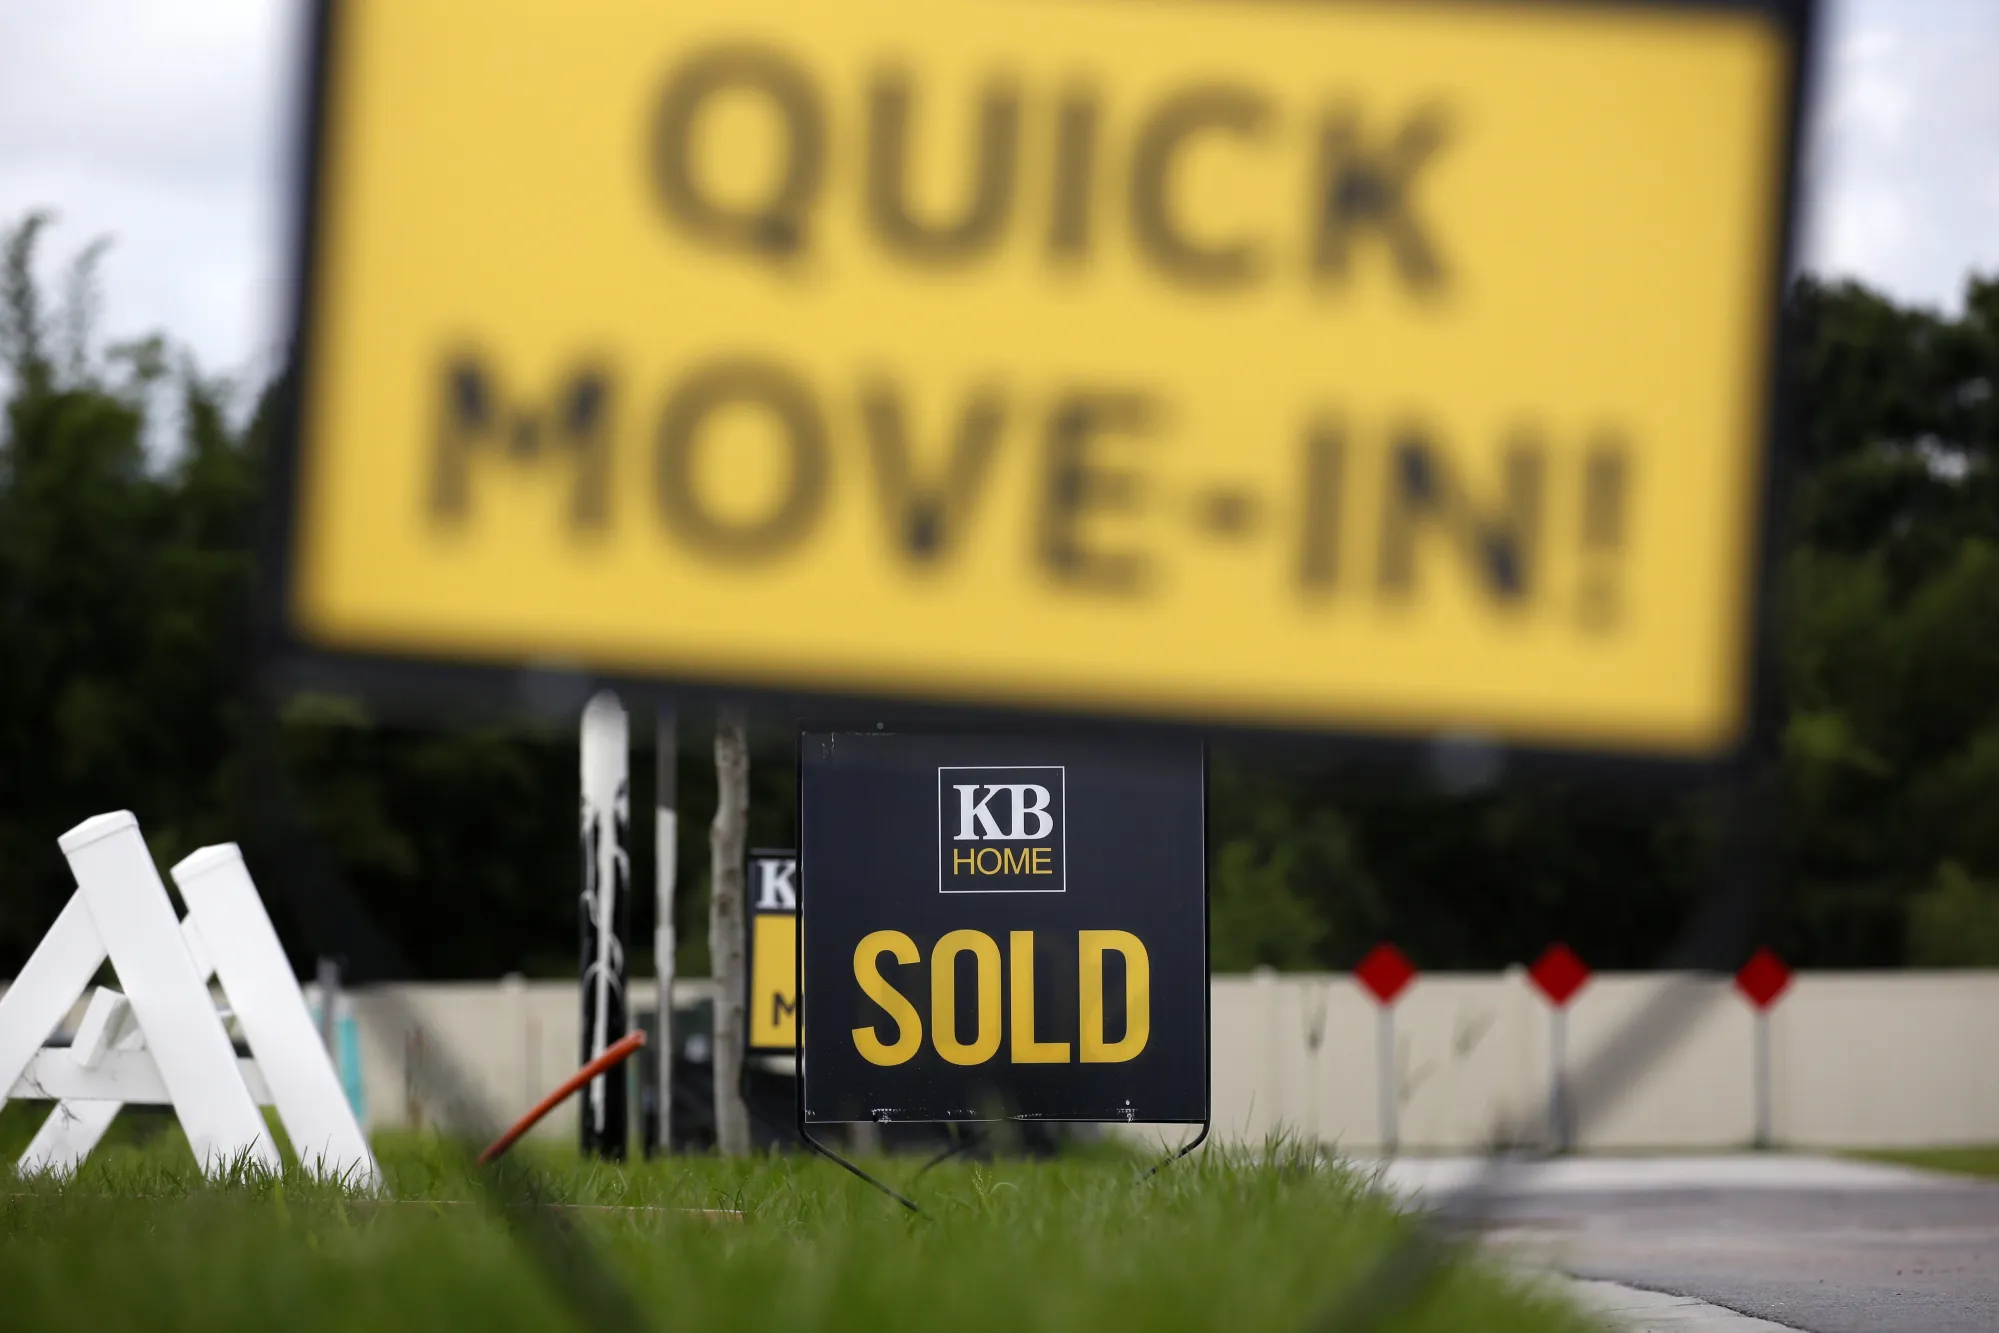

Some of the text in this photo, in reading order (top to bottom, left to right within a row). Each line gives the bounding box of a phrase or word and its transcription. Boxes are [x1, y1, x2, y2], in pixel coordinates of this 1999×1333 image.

[642, 44, 1464, 304] QUICK
[426, 340, 1634, 635] MOVE-IN!
[953, 784, 1053, 840] KB
[953, 848, 1053, 875] HOME
[851, 929, 1150, 1066] SOLD
